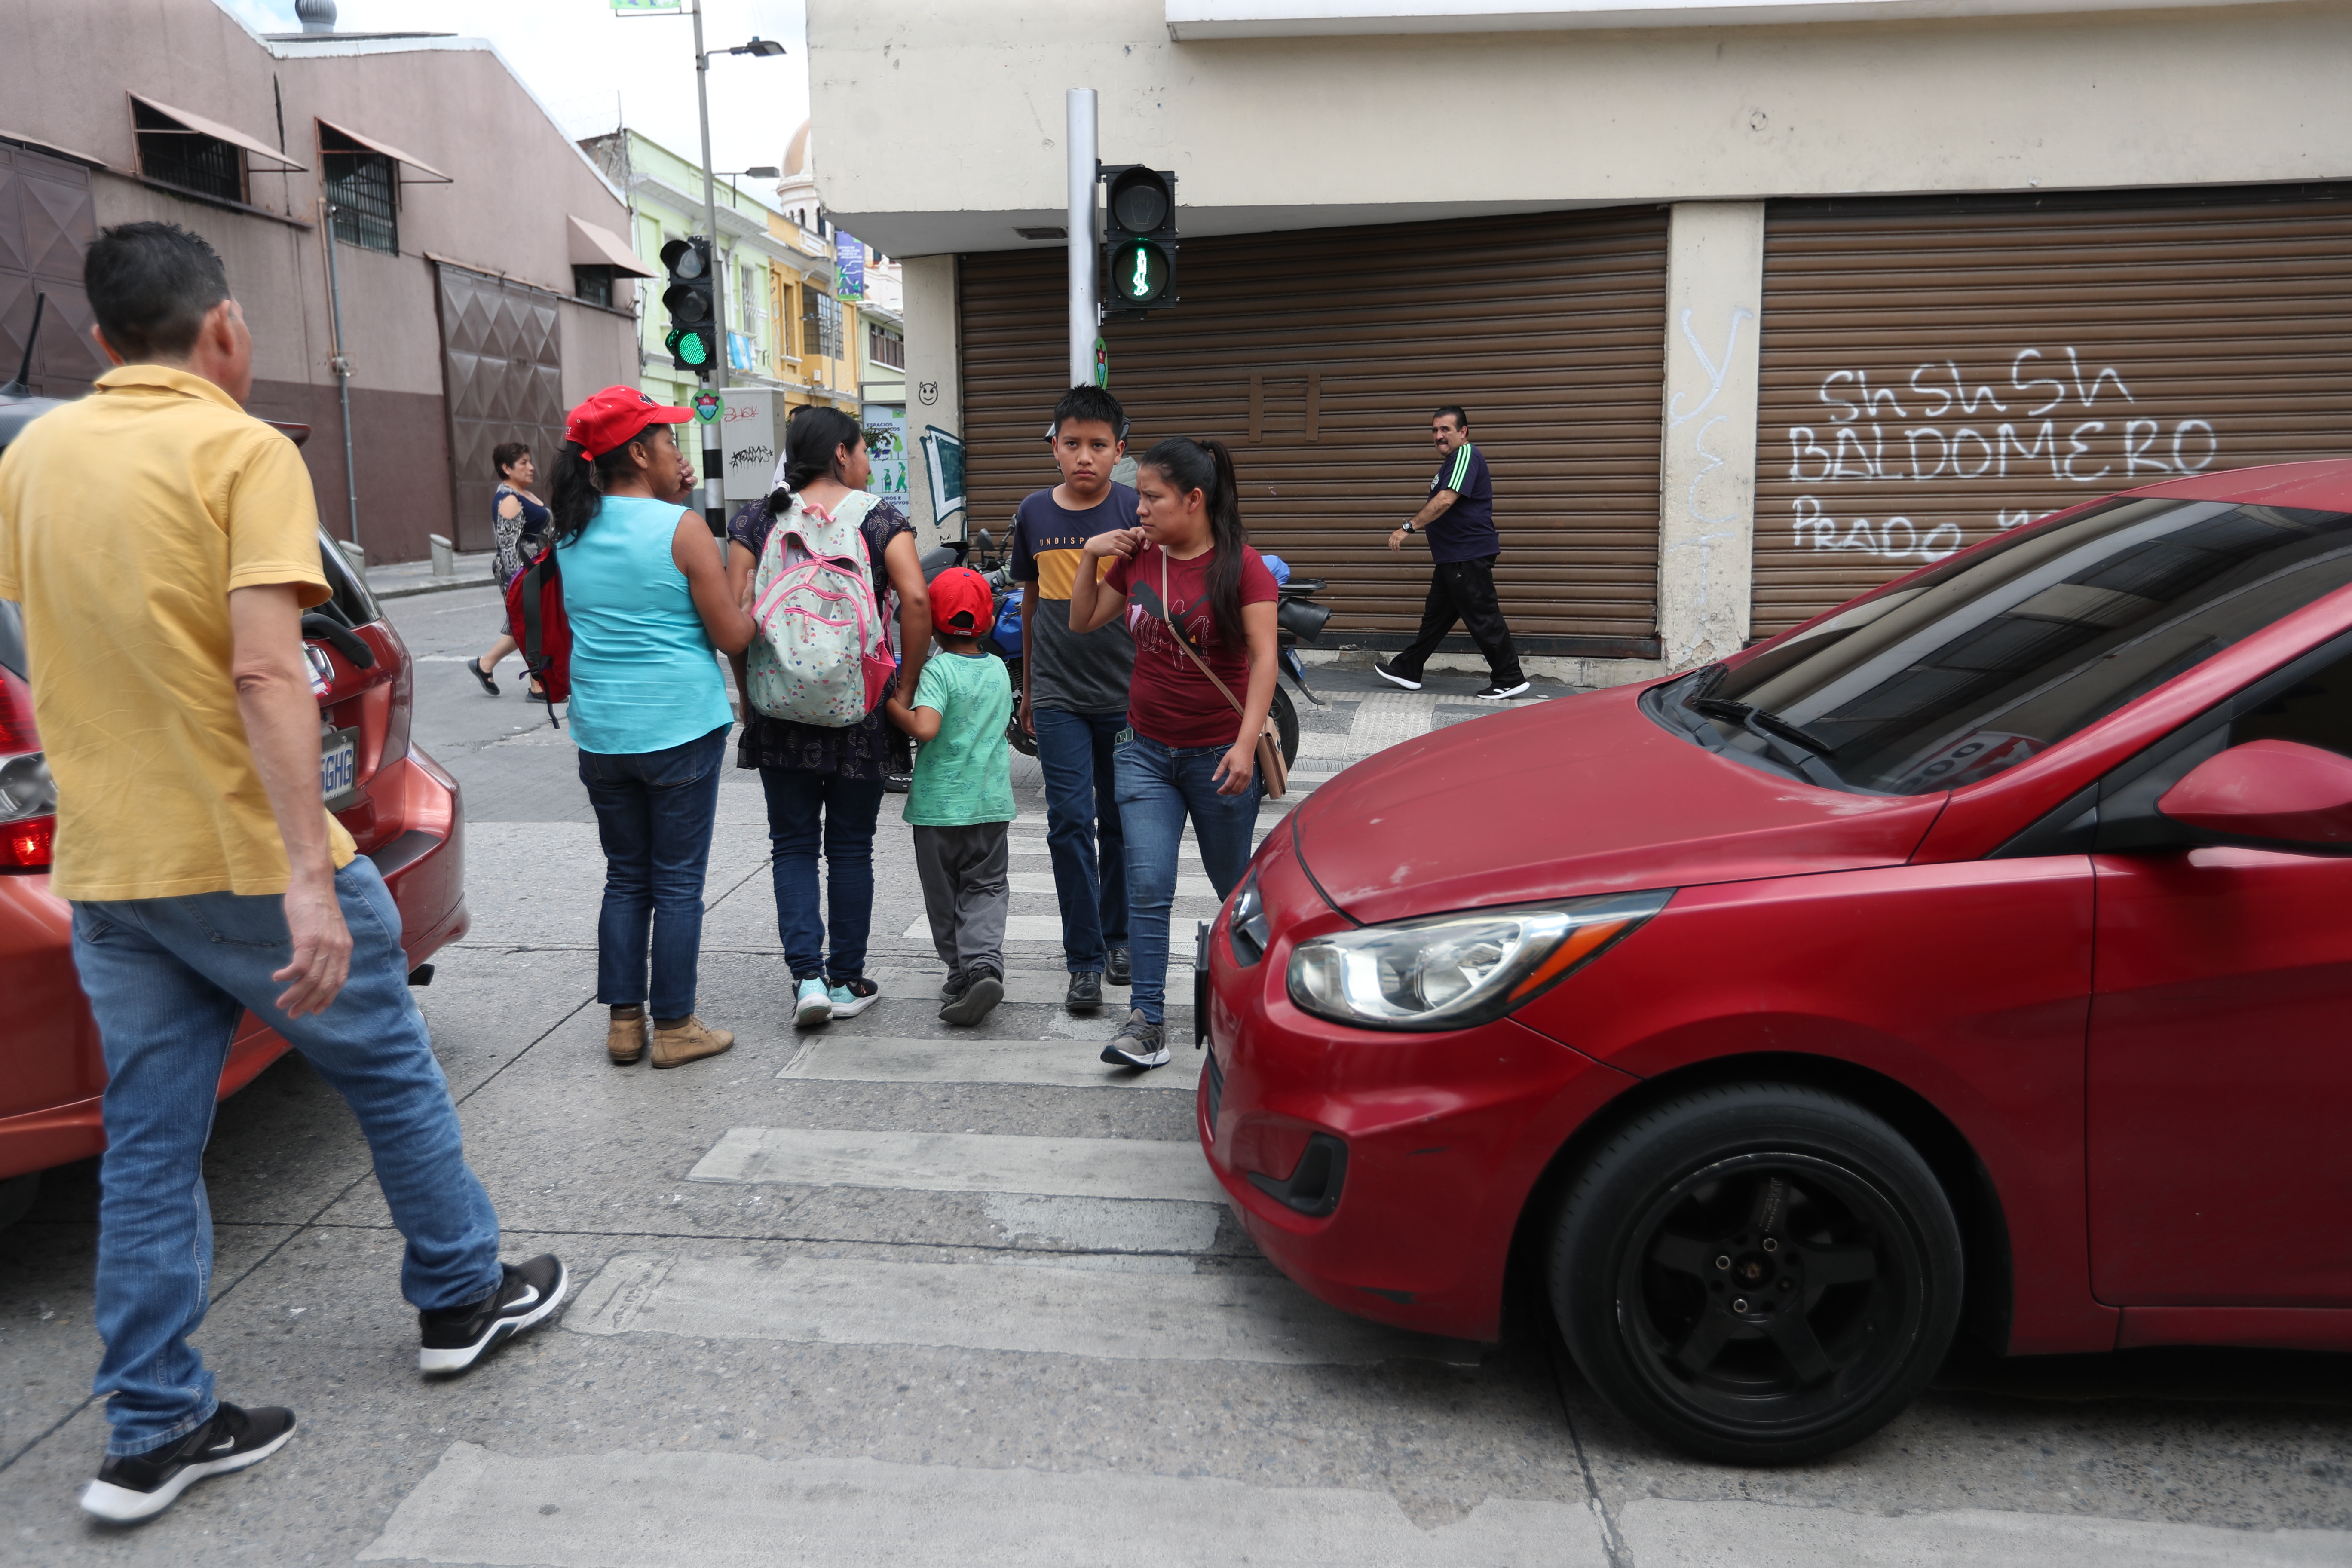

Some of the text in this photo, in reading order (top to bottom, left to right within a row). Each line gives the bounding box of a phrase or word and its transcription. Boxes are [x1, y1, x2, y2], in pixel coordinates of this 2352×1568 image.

[1789, 419, 2217, 482] BALDOMERO
[1040, 537, 1092, 546] UNDISP
[1793, 495, 1961, 562] PRADO
[1768, 1177, 1783, 1198] GT
